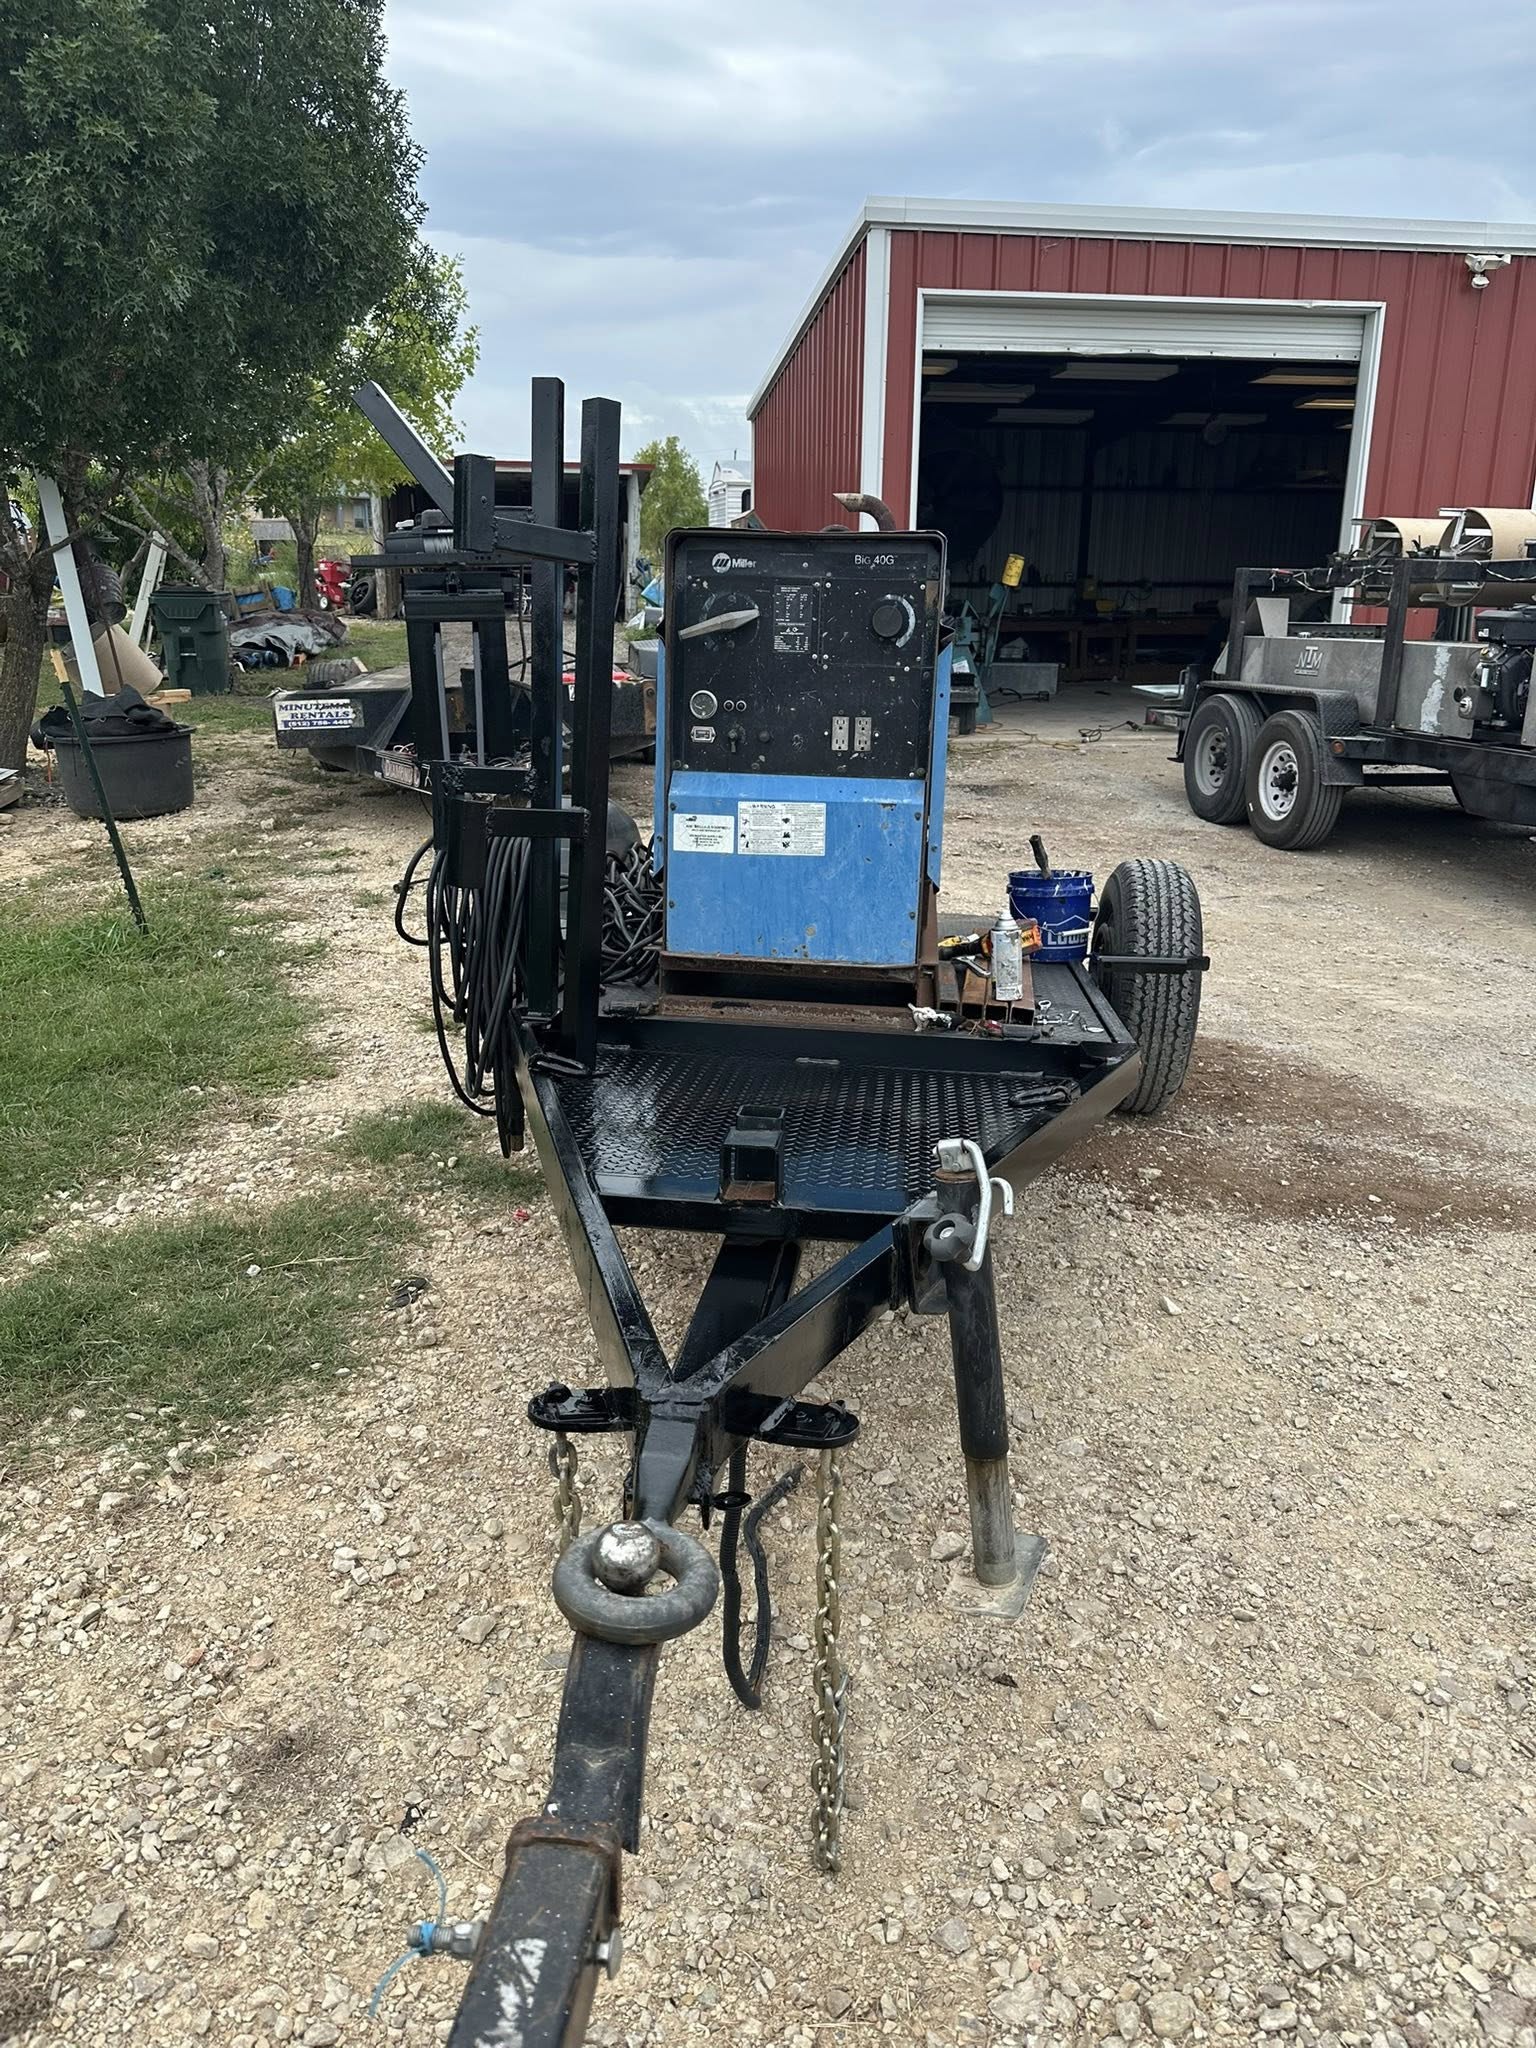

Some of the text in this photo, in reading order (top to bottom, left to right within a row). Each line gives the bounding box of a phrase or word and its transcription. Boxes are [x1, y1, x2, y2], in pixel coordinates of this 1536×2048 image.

[731, 558, 757, 568] Miller
[873, 554, 895, 565] 40G
[290, 710, 350, 719] RENTALS
